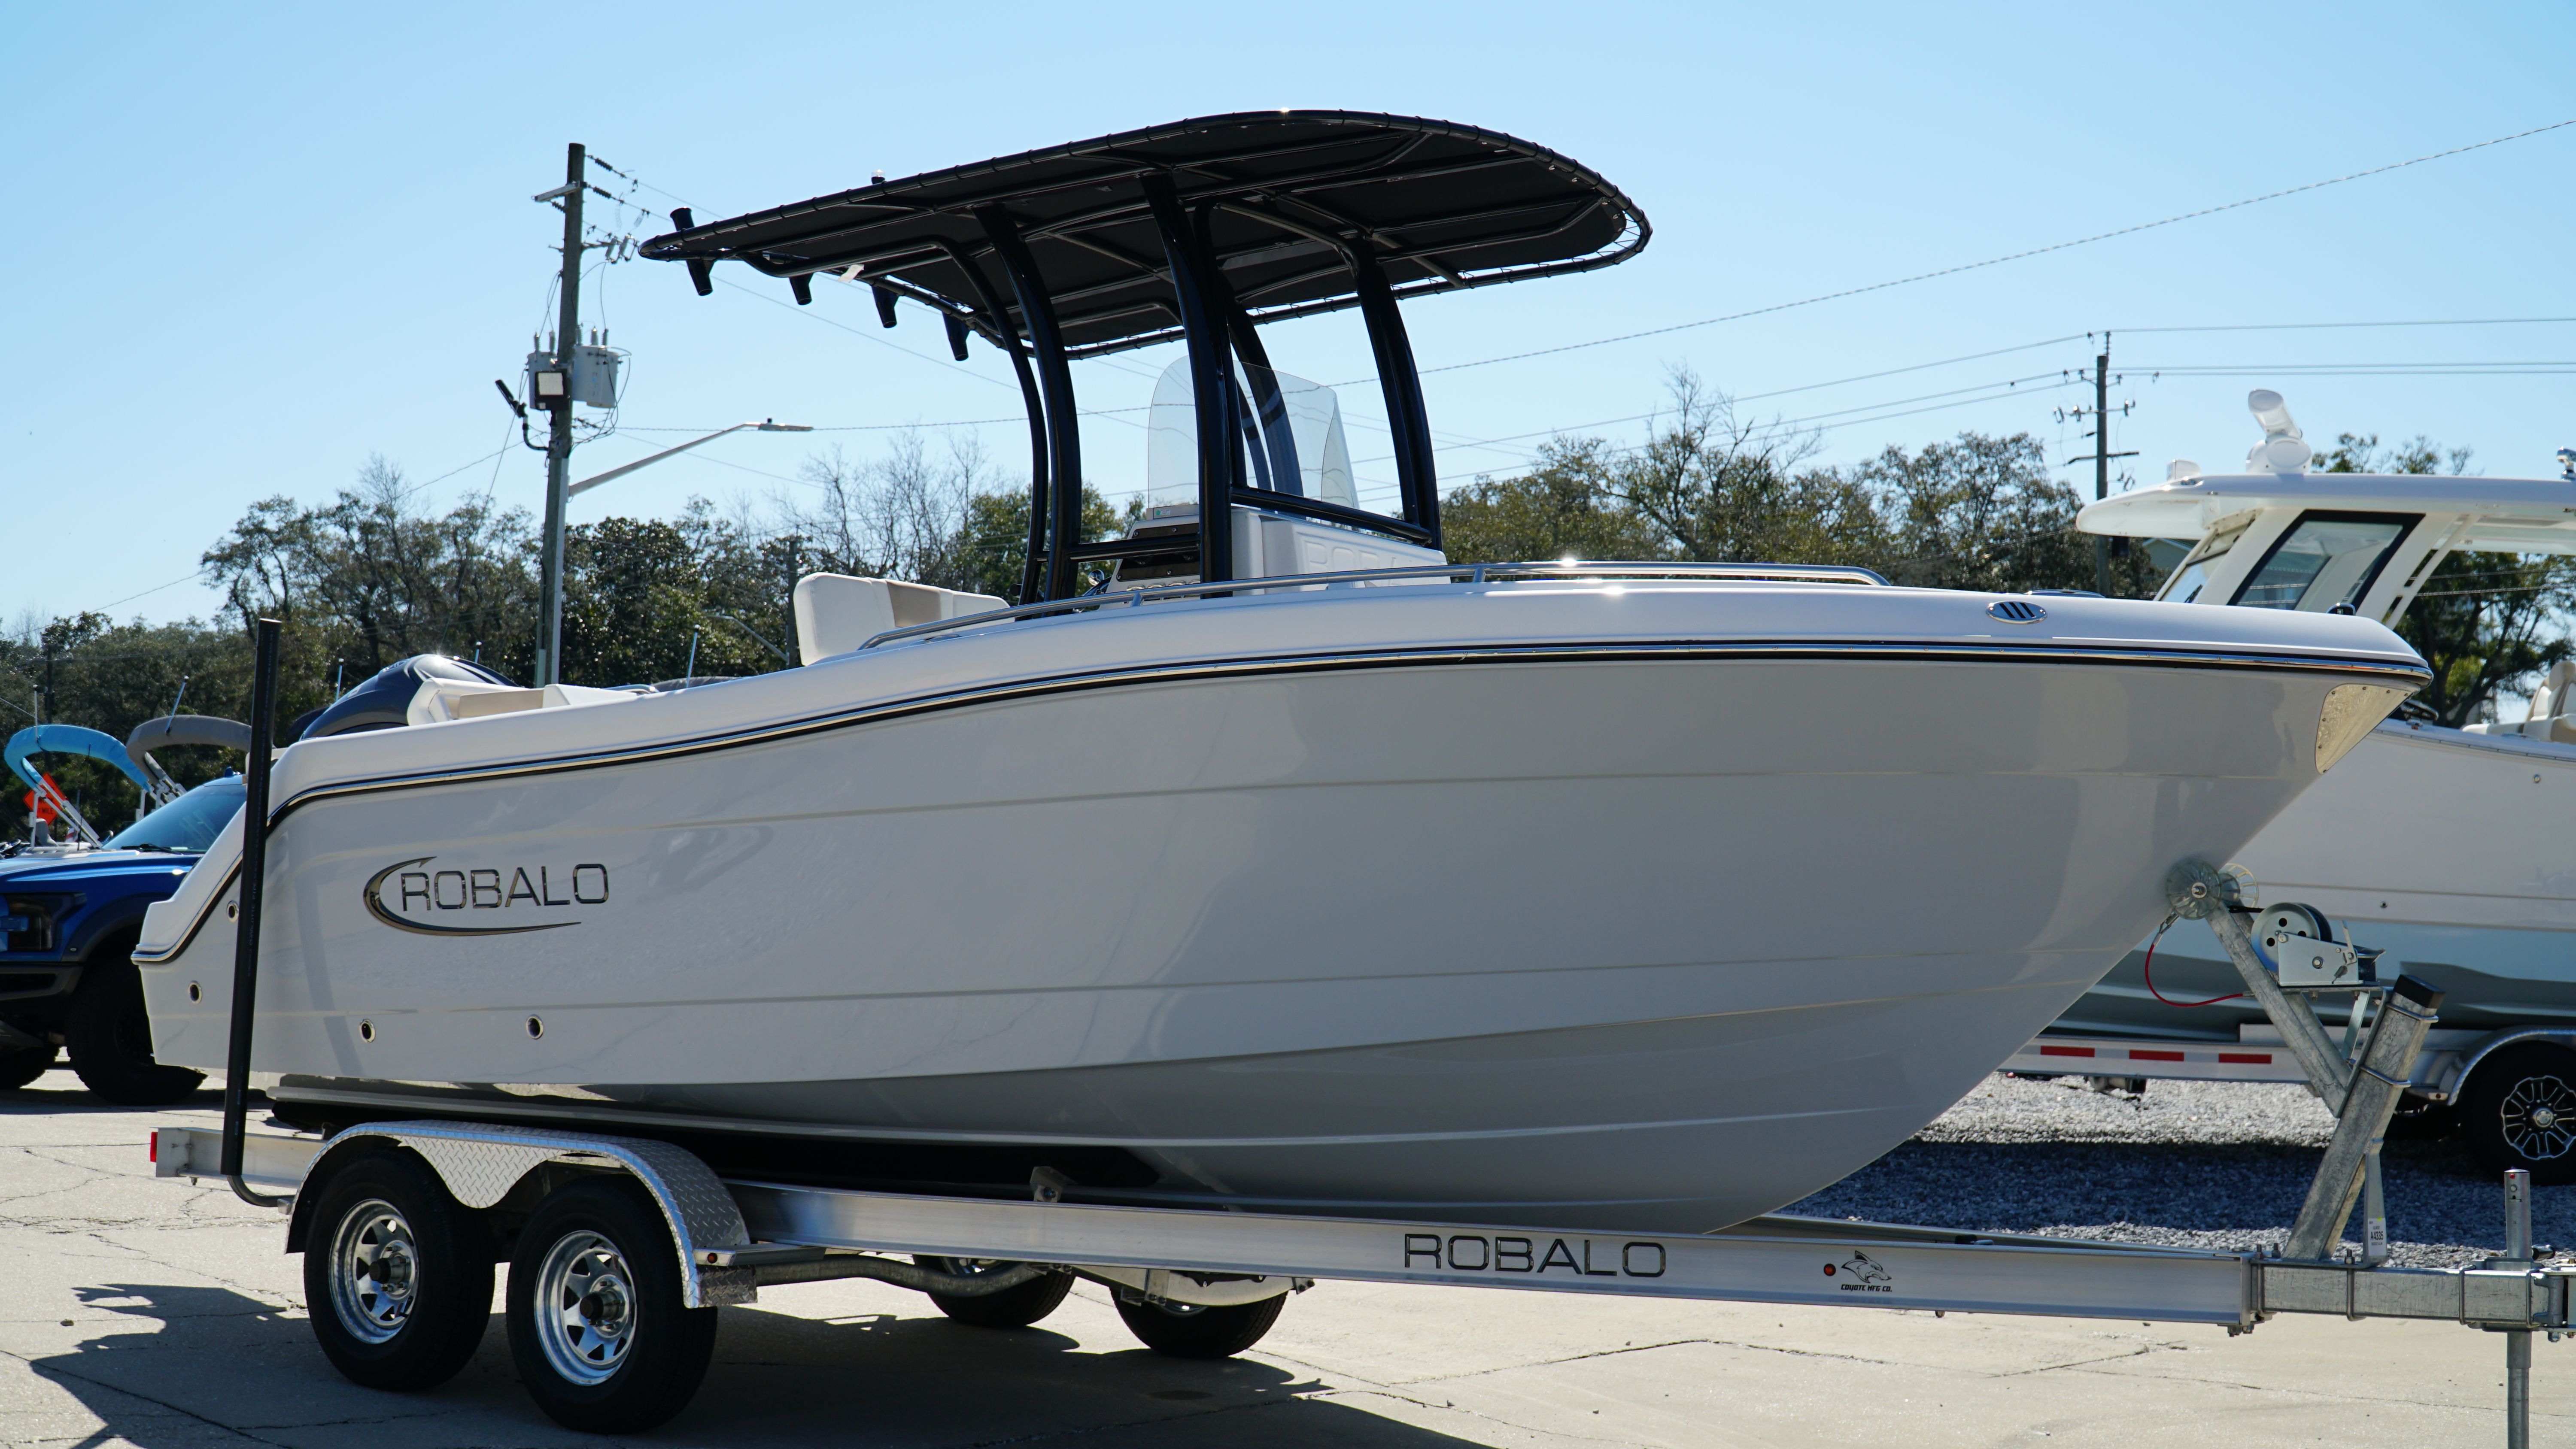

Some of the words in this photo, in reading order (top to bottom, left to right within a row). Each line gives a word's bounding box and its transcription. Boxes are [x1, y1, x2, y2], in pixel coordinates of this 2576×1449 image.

[401, 863, 609, 911] ROBALO
[1404, 1233, 1666, 1277] ROBALO
[2370, 1231, 2384, 1240] A4335
